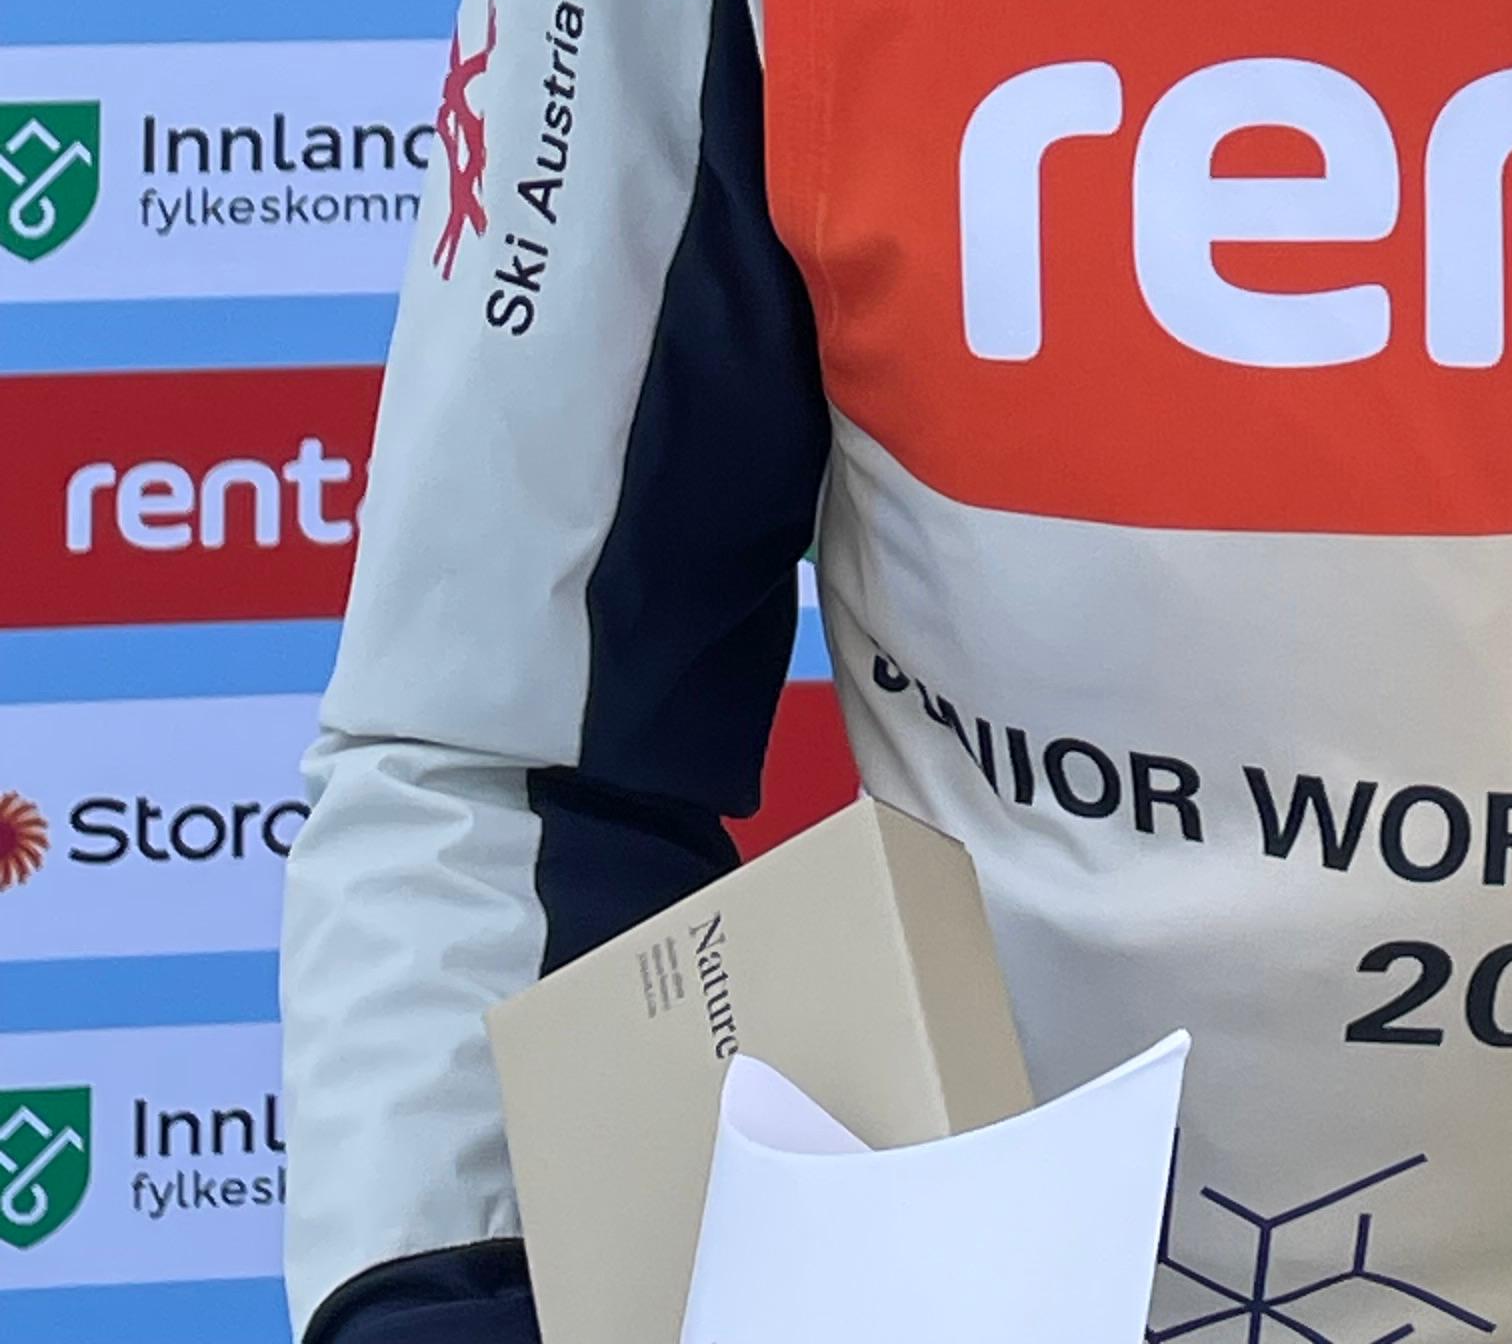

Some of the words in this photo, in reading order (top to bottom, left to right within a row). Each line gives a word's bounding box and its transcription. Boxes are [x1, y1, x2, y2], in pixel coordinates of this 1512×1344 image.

[517, 0, 586, 226] Austria
[485, 232, 550, 337] Ski
[65, 437, 370, 555] rent
